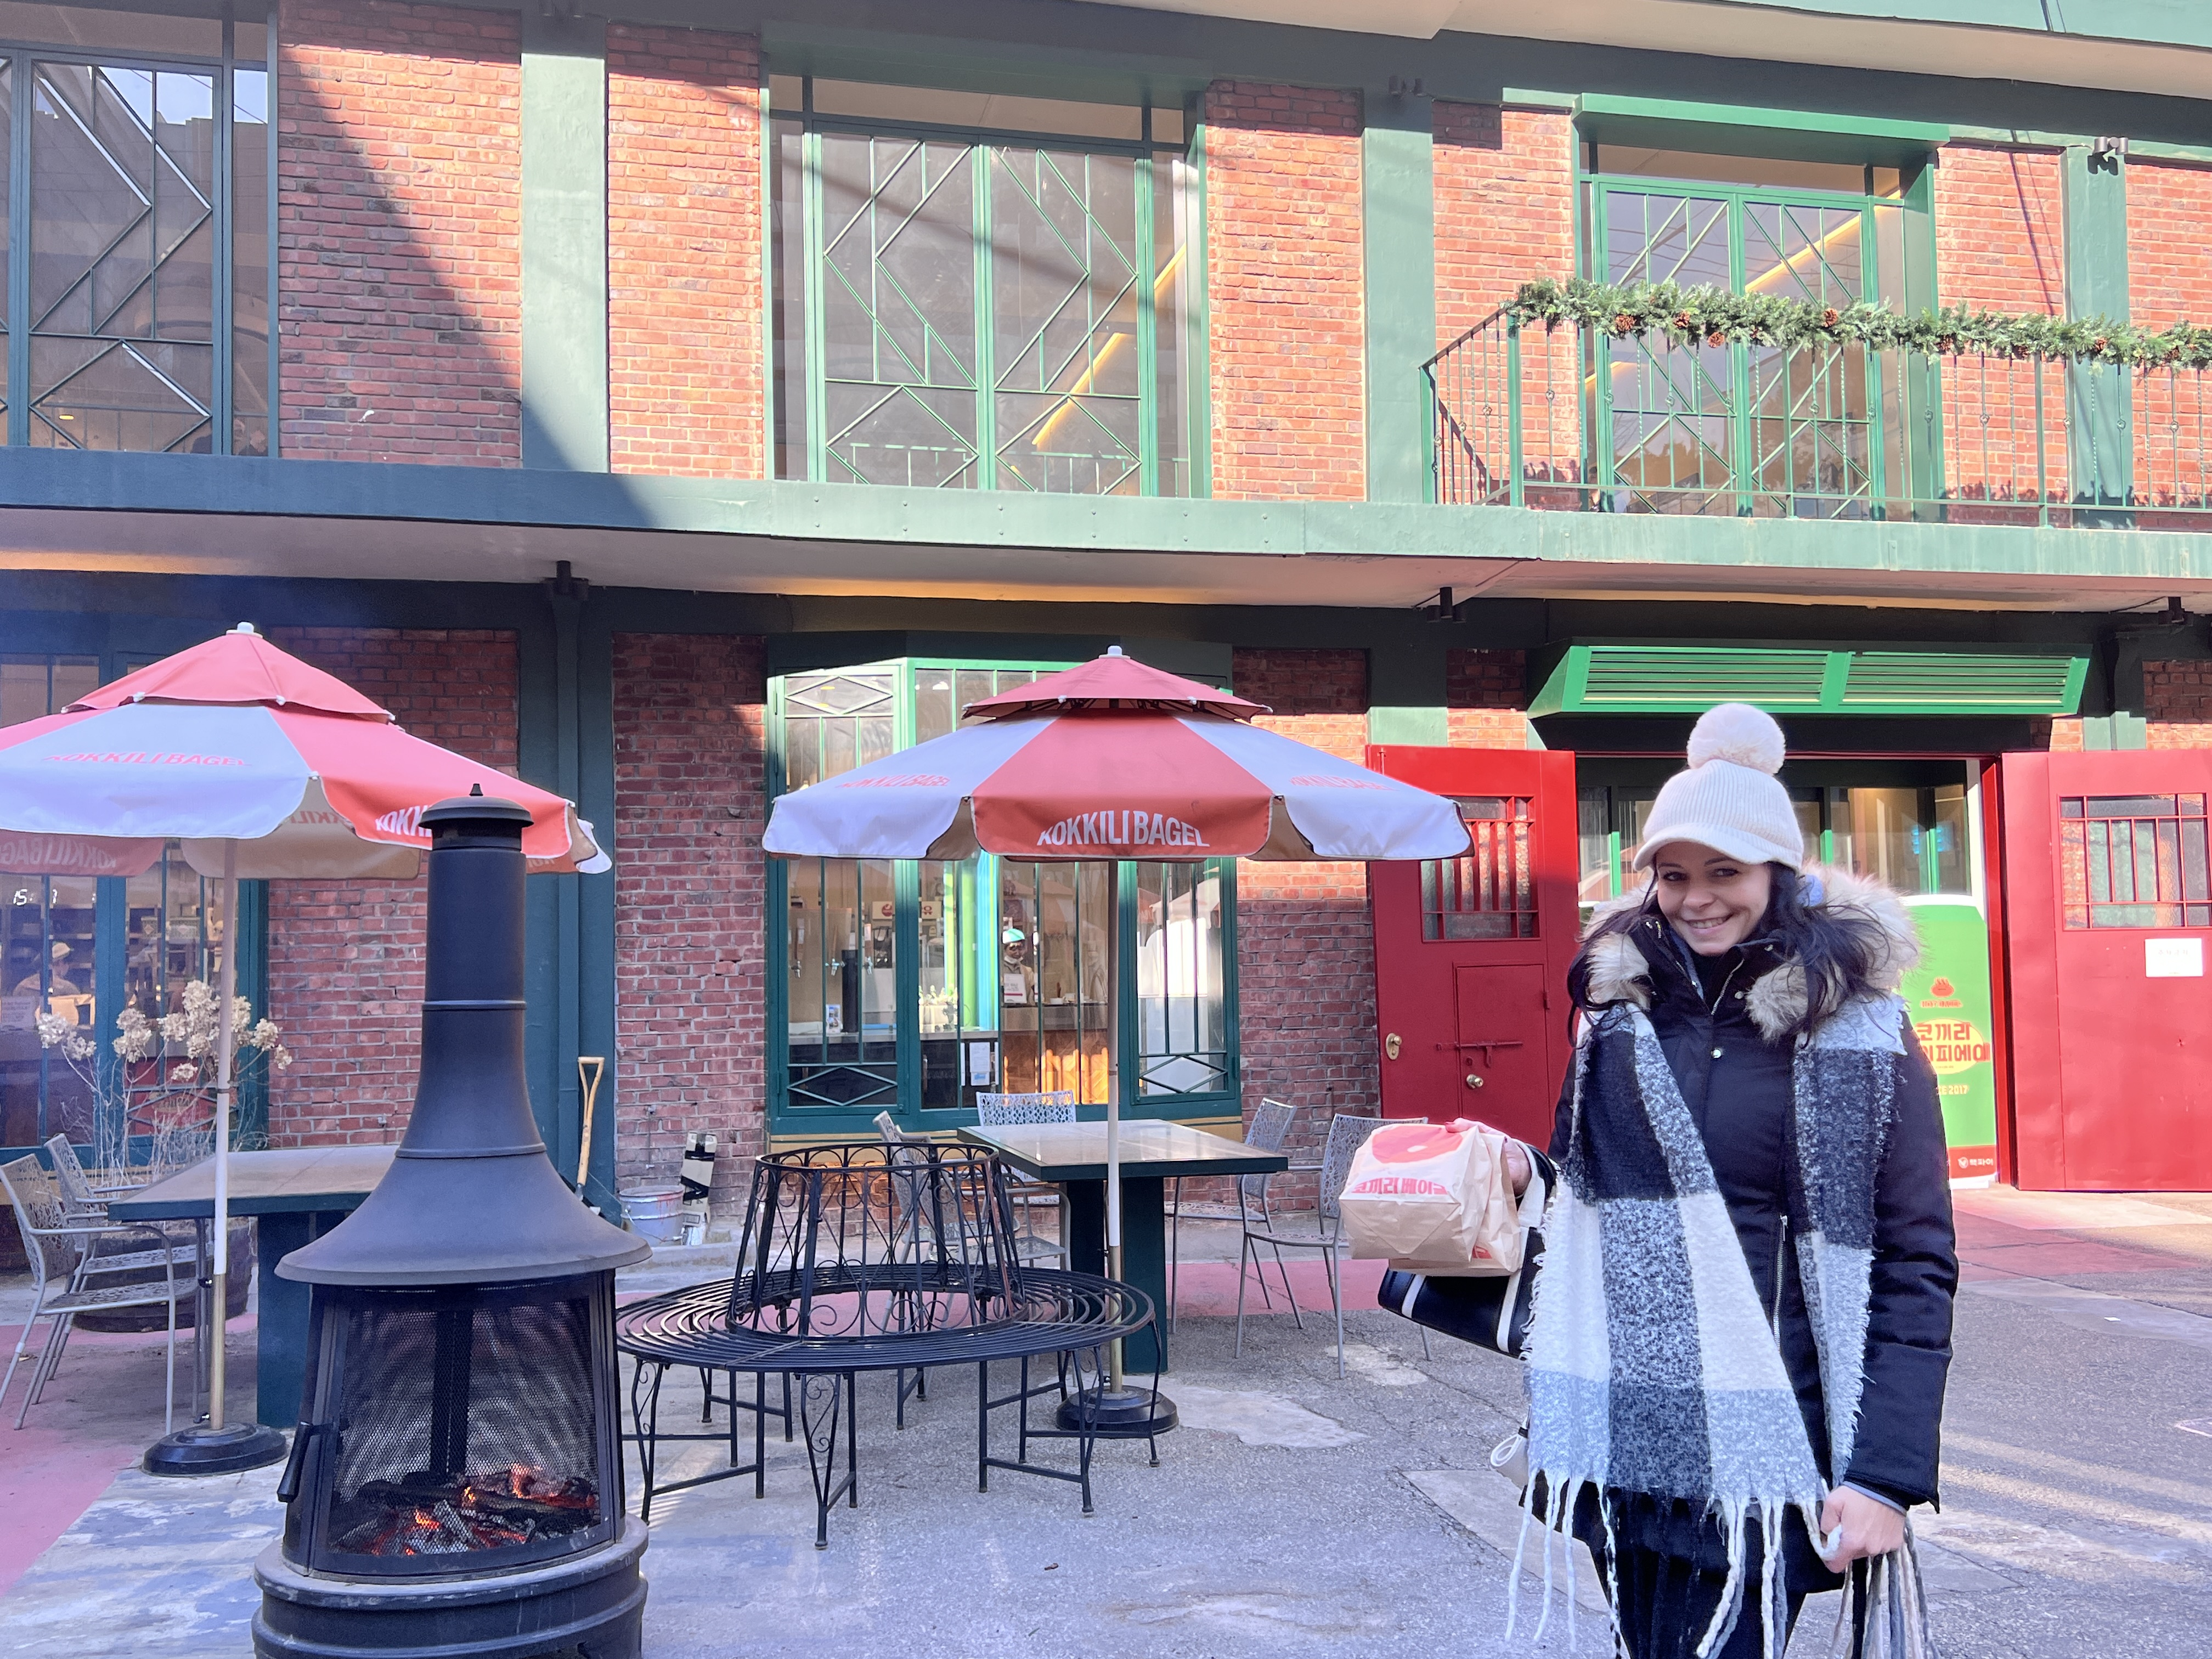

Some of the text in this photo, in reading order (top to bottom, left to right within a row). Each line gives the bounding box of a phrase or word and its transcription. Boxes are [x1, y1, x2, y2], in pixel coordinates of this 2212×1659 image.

[42, 752, 252, 766] KOKKILI BAGEL
[375, 805, 432, 838] KOKK
[1036, 810, 1210, 847] KOKKILI BAGEL
[1915, 1022, 1971, 1041] 코끼리
[1948, 1085, 1968, 1095] 2017
